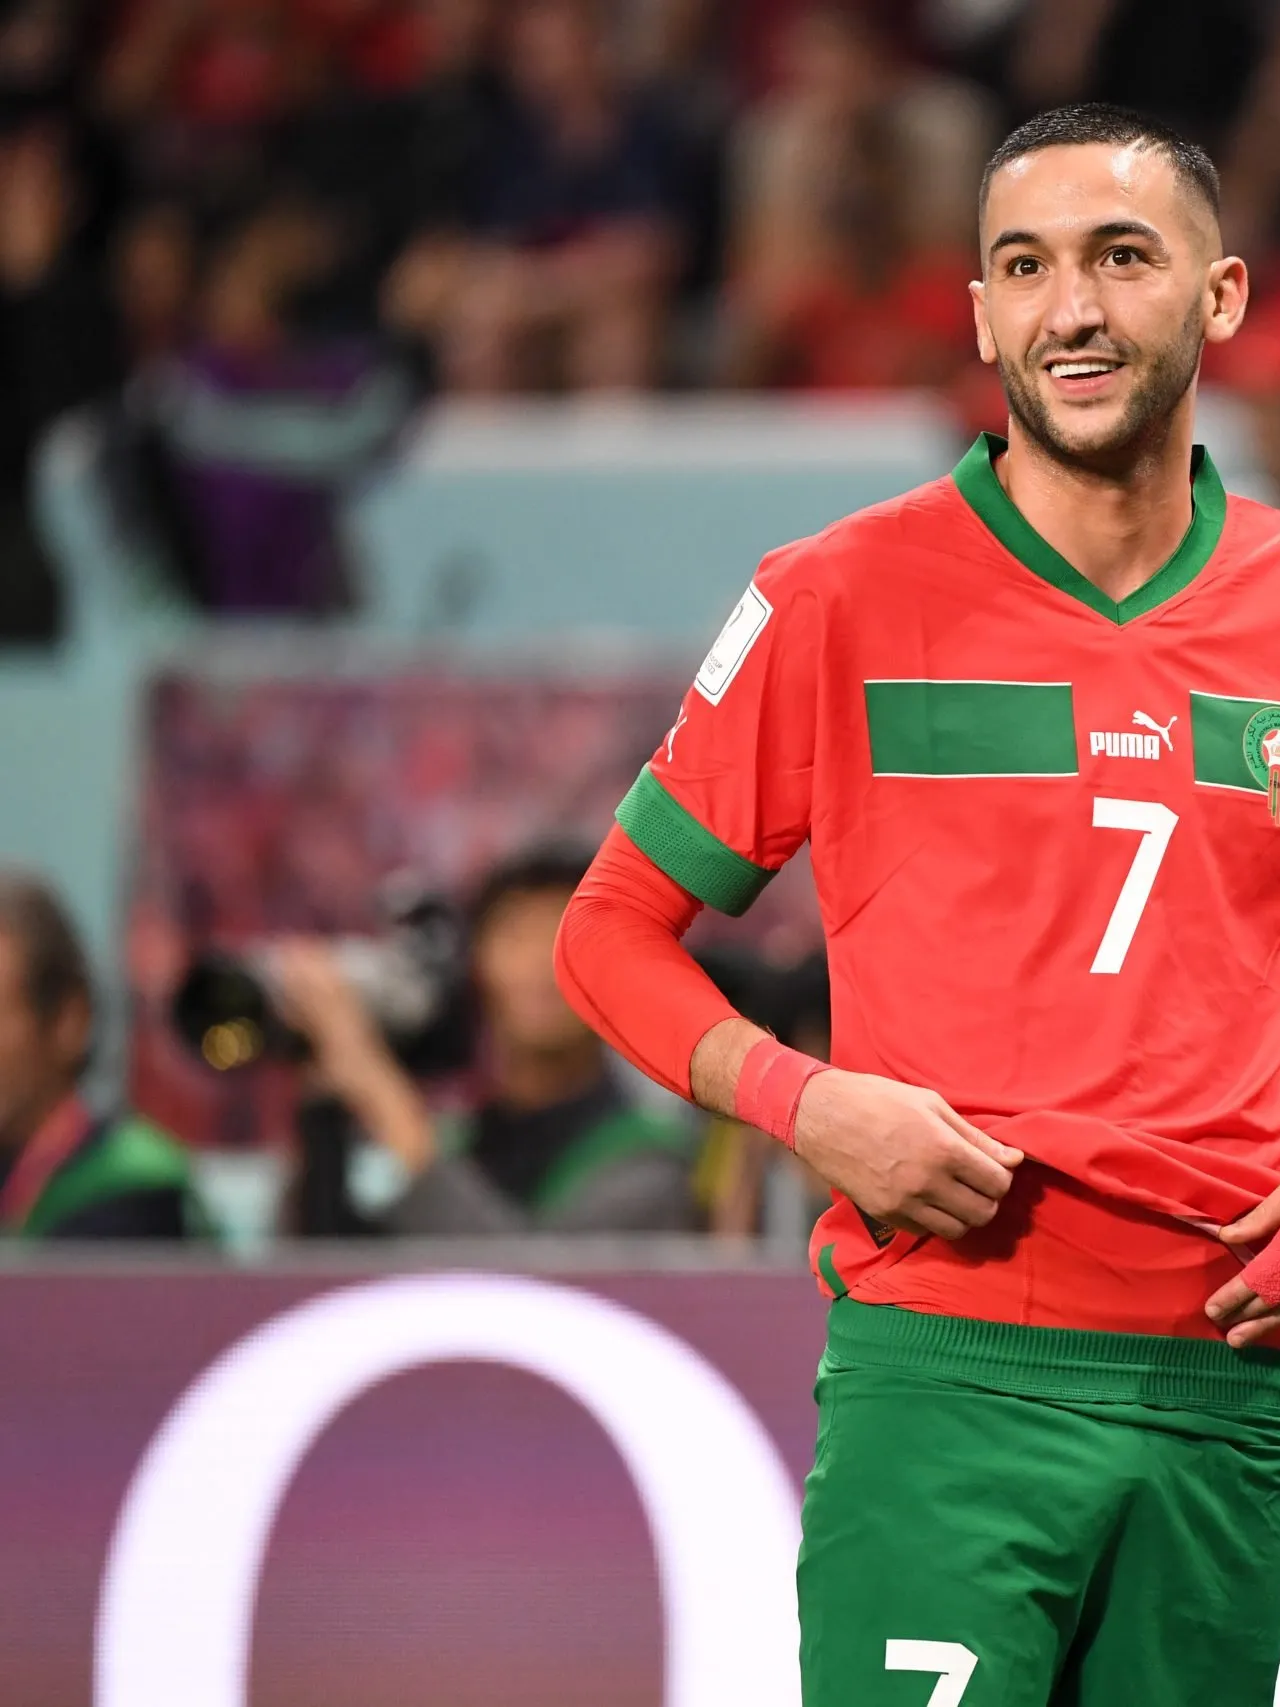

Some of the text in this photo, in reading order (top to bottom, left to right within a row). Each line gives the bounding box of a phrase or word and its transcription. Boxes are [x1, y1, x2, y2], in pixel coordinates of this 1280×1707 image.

[1089, 731, 1160, 760] PUMA
[1089, 796, 1180, 974] 7
[884, 1638, 979, 1707] 7
